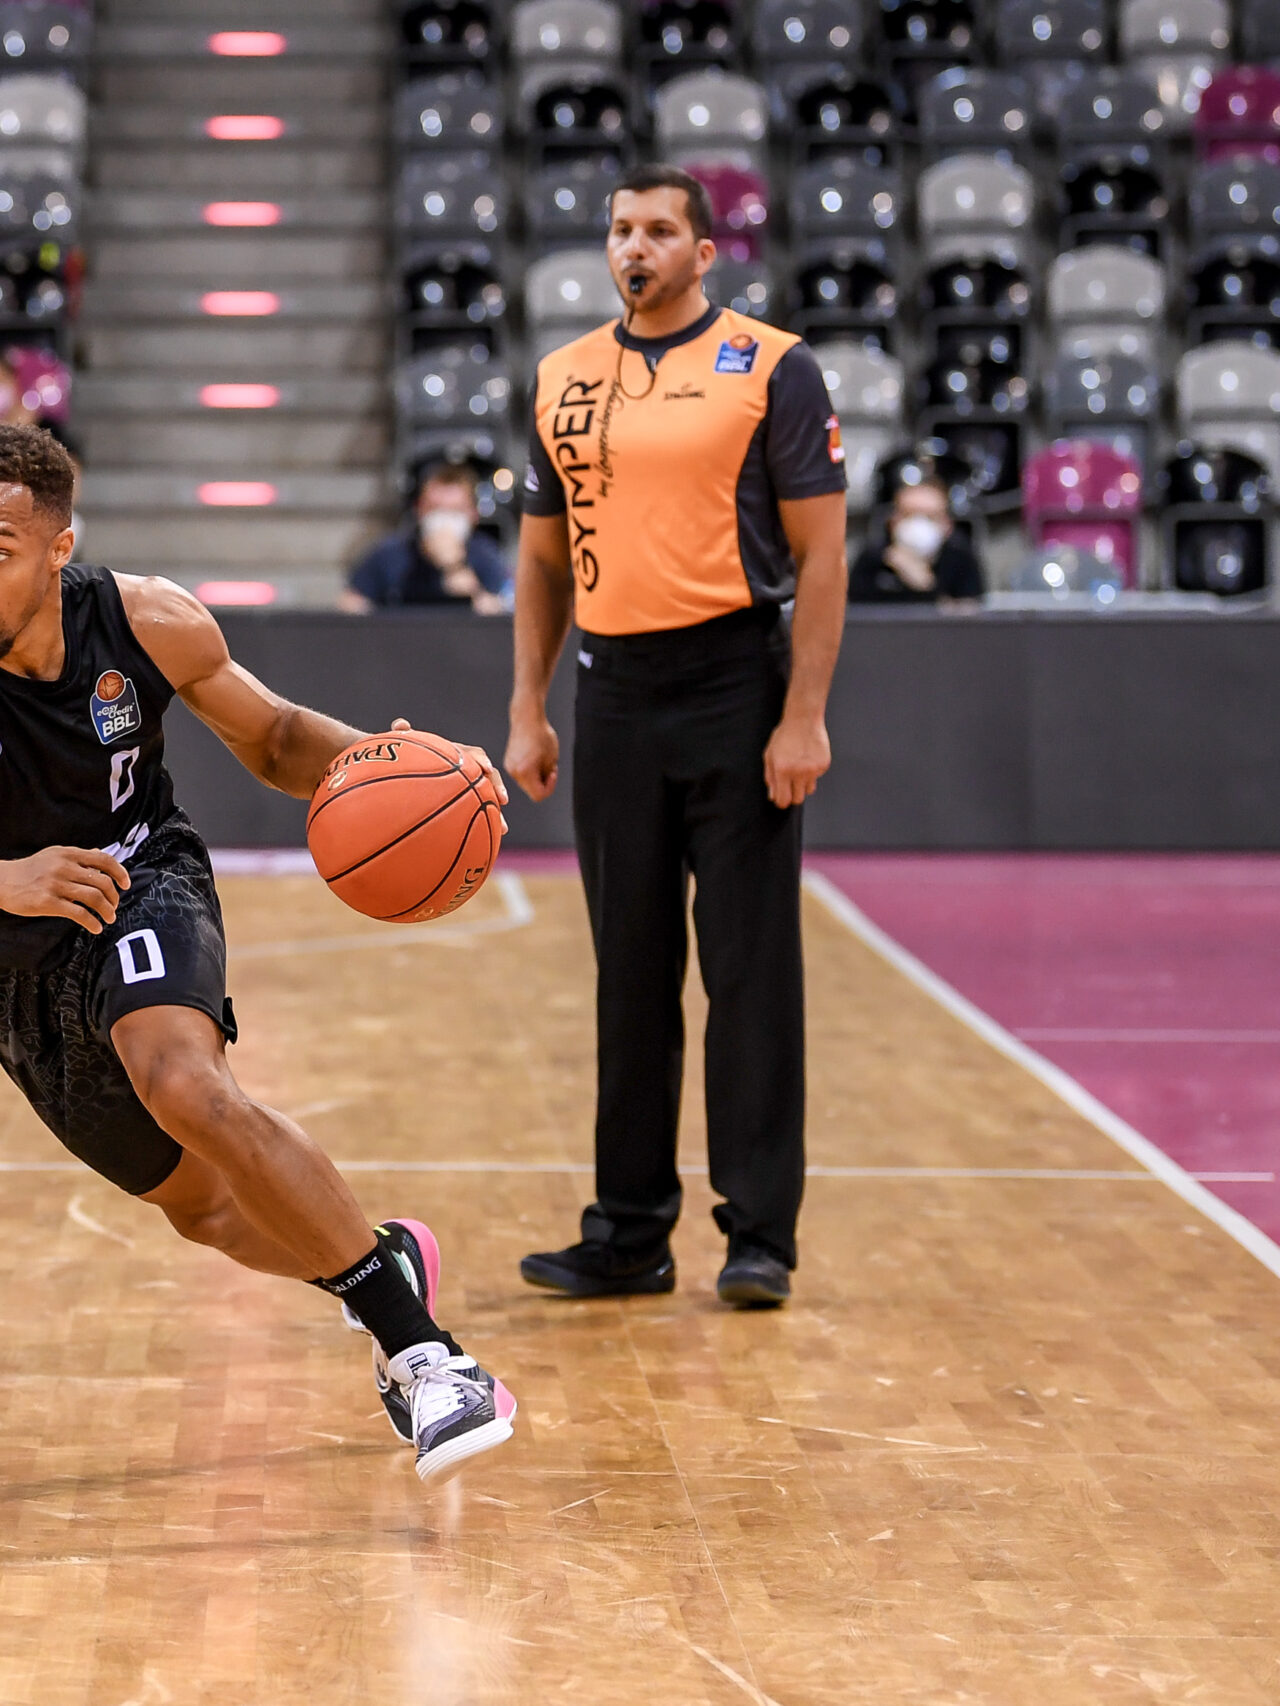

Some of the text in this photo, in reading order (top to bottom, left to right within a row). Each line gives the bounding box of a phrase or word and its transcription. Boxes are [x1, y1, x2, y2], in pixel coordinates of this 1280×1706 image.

[553, 379, 604, 592] GYMPER
[102, 714, 136, 737] BBL
[109, 746, 140, 812] 0
[115, 928, 166, 984] 0
[330, 1255, 382, 1293] ALDING
